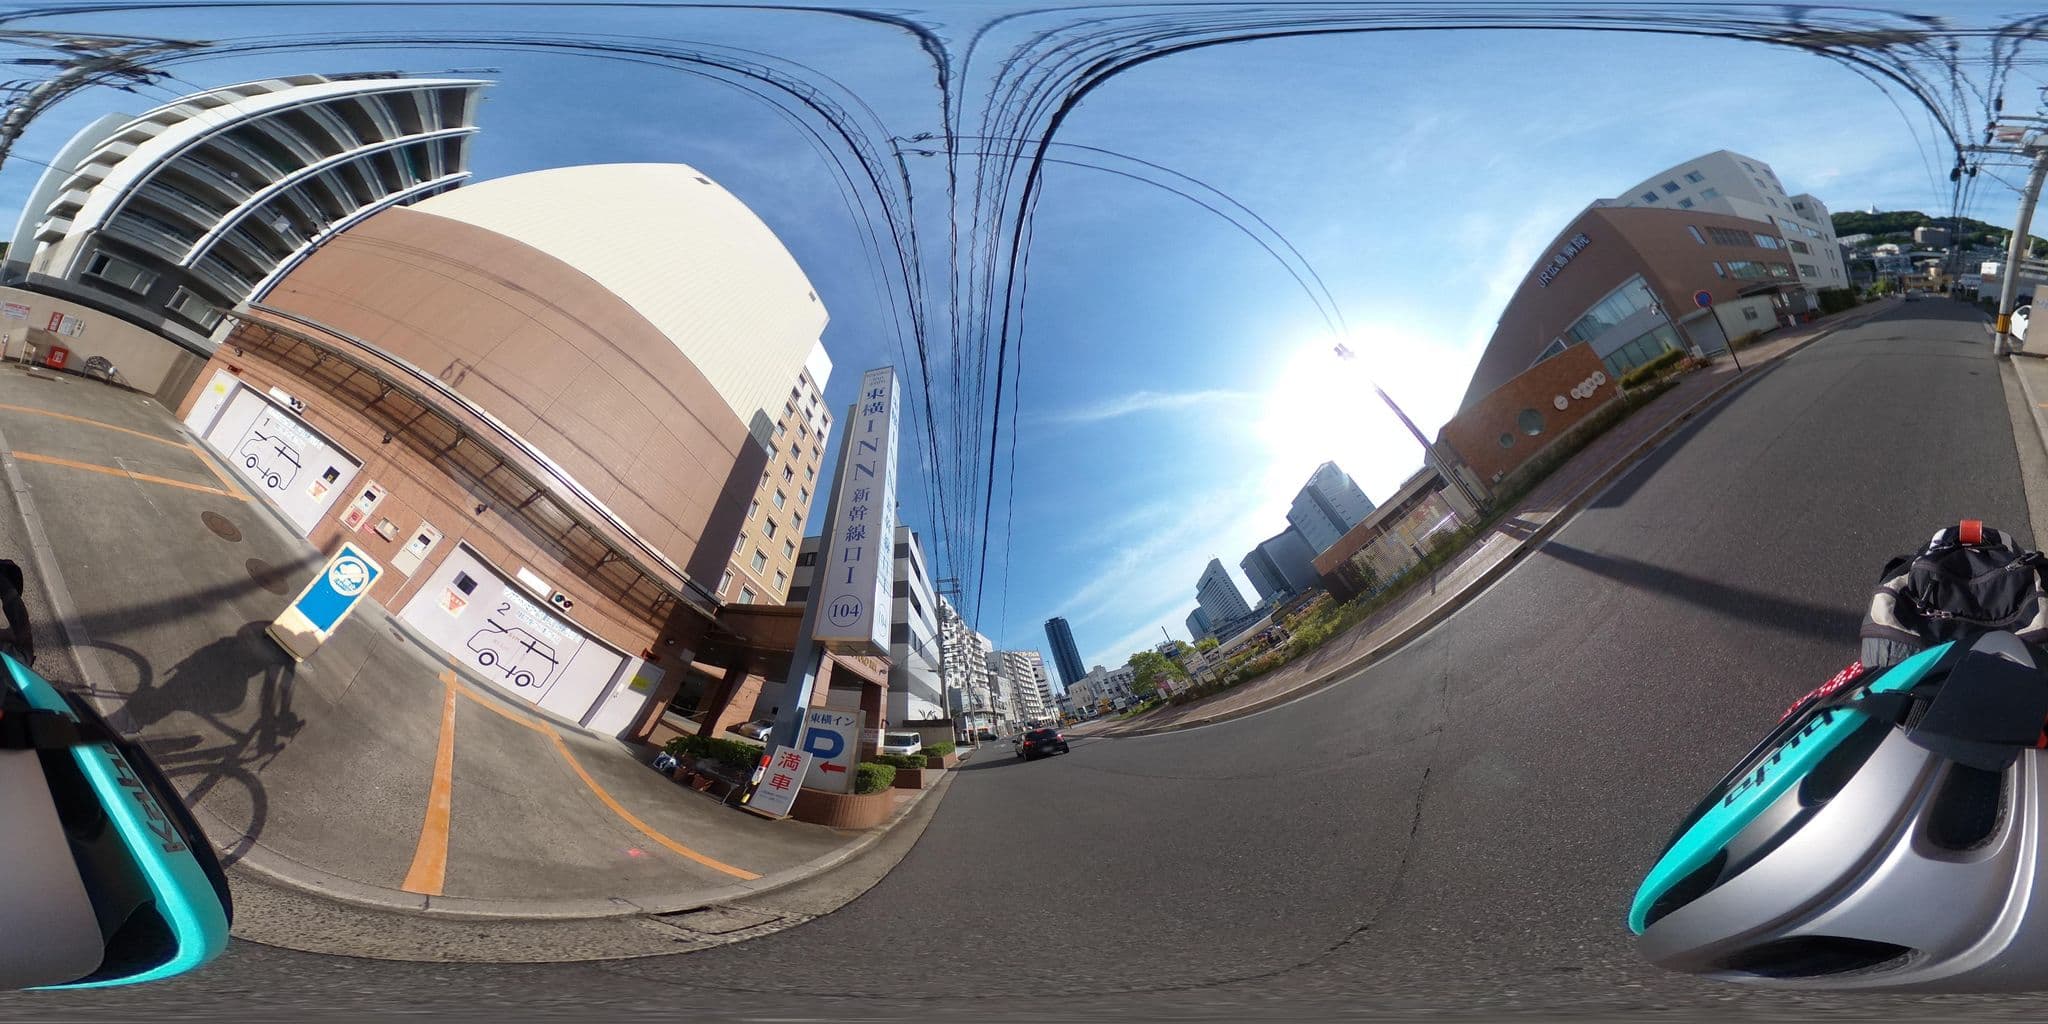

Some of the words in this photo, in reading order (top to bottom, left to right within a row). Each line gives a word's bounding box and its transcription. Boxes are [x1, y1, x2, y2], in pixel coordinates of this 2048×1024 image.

[263, 417, 271, 427] 1
[496, 601, 511, 616] 2
[830, 601, 860, 619] 104
[810, 712, 855, 727] 東横イン
[804, 727, 845, 759] P
[1723, 708, 1837, 808] buto
[768, 751, 802, 791] 満車
[103, 744, 187, 854] Kab
